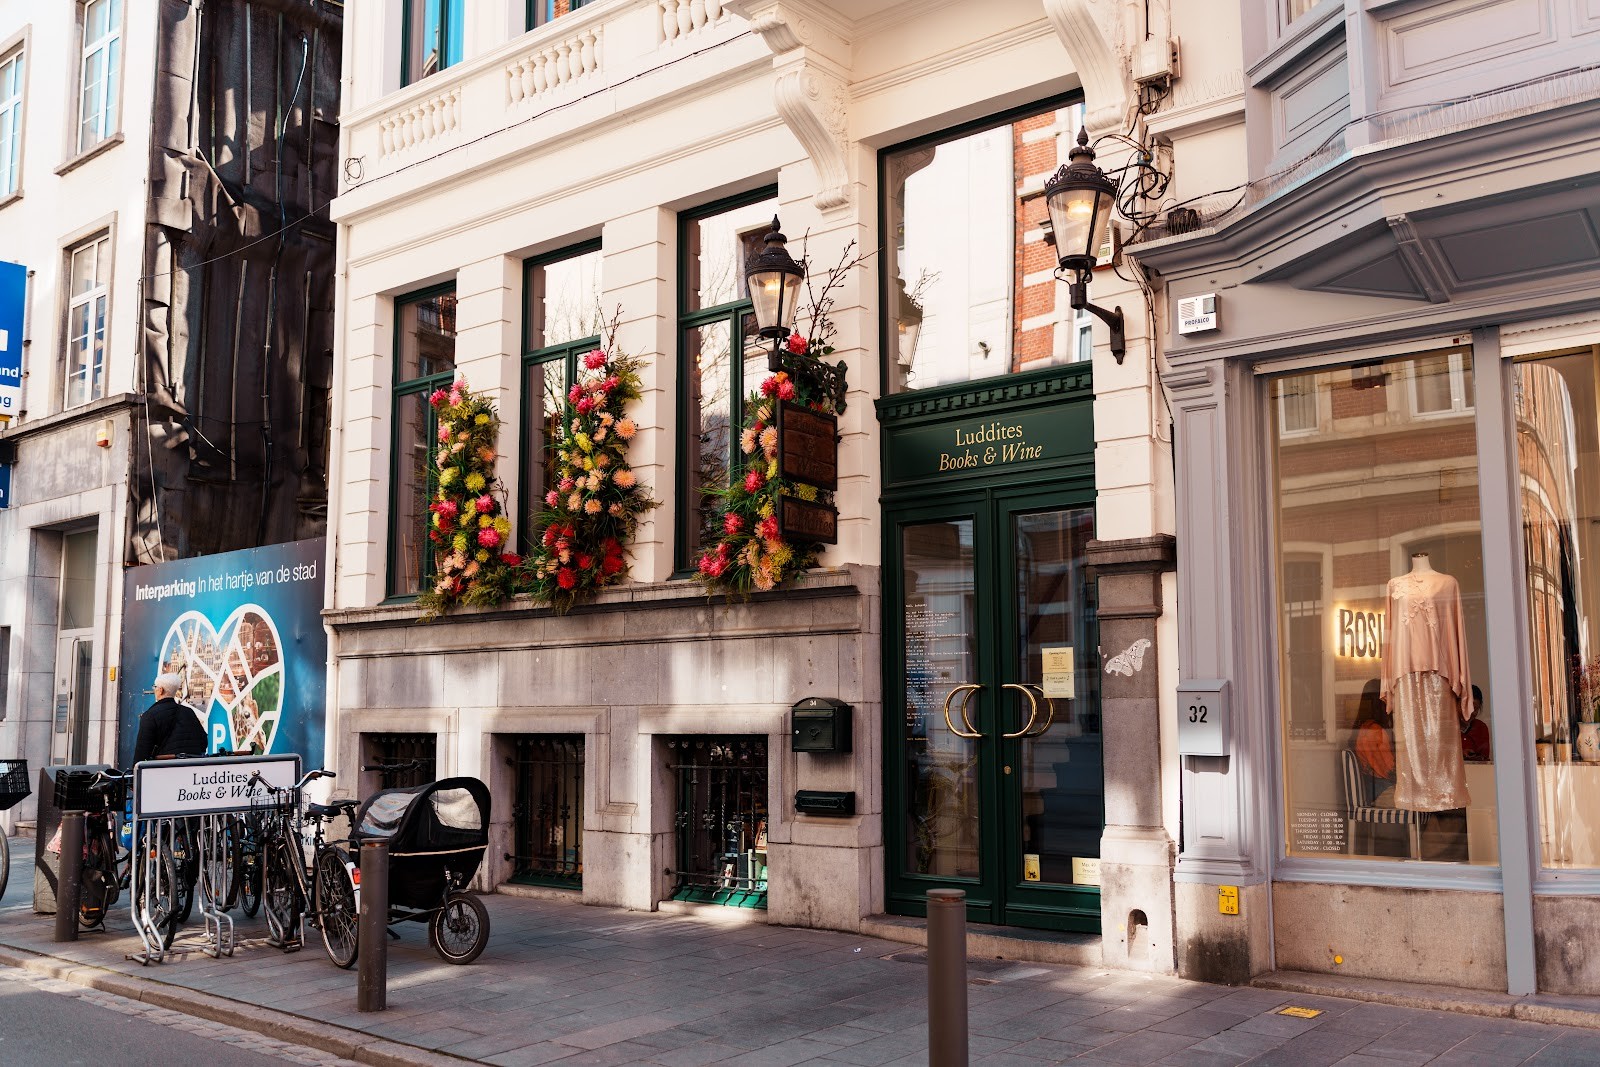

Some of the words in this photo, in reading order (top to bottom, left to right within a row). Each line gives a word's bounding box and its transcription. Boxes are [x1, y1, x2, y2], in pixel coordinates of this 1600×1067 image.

[1184, 317, 1210, 326] PROFALCO
[0, 366, 19, 378] nd
[955, 422, 1022, 446] Luddites
[939, 449, 979, 471] Books
[983, 446, 997, 464] &
[1002, 441, 1042, 462] Wine
[136, 578, 196, 602] Interparking
[198, 576, 206, 593] In
[208, 574, 223, 592] het
[225, 570, 253, 592] hartje
[256, 570, 273, 586] van
[276, 564, 290, 583] de
[292, 560, 317, 582] stad
[1339, 608, 1385, 658] ROSI
[1189, 705, 1208, 723] 32
[193, 770, 248, 785] Luddites
[177, 787, 212, 801] Books
[215, 786, 226, 798] &
